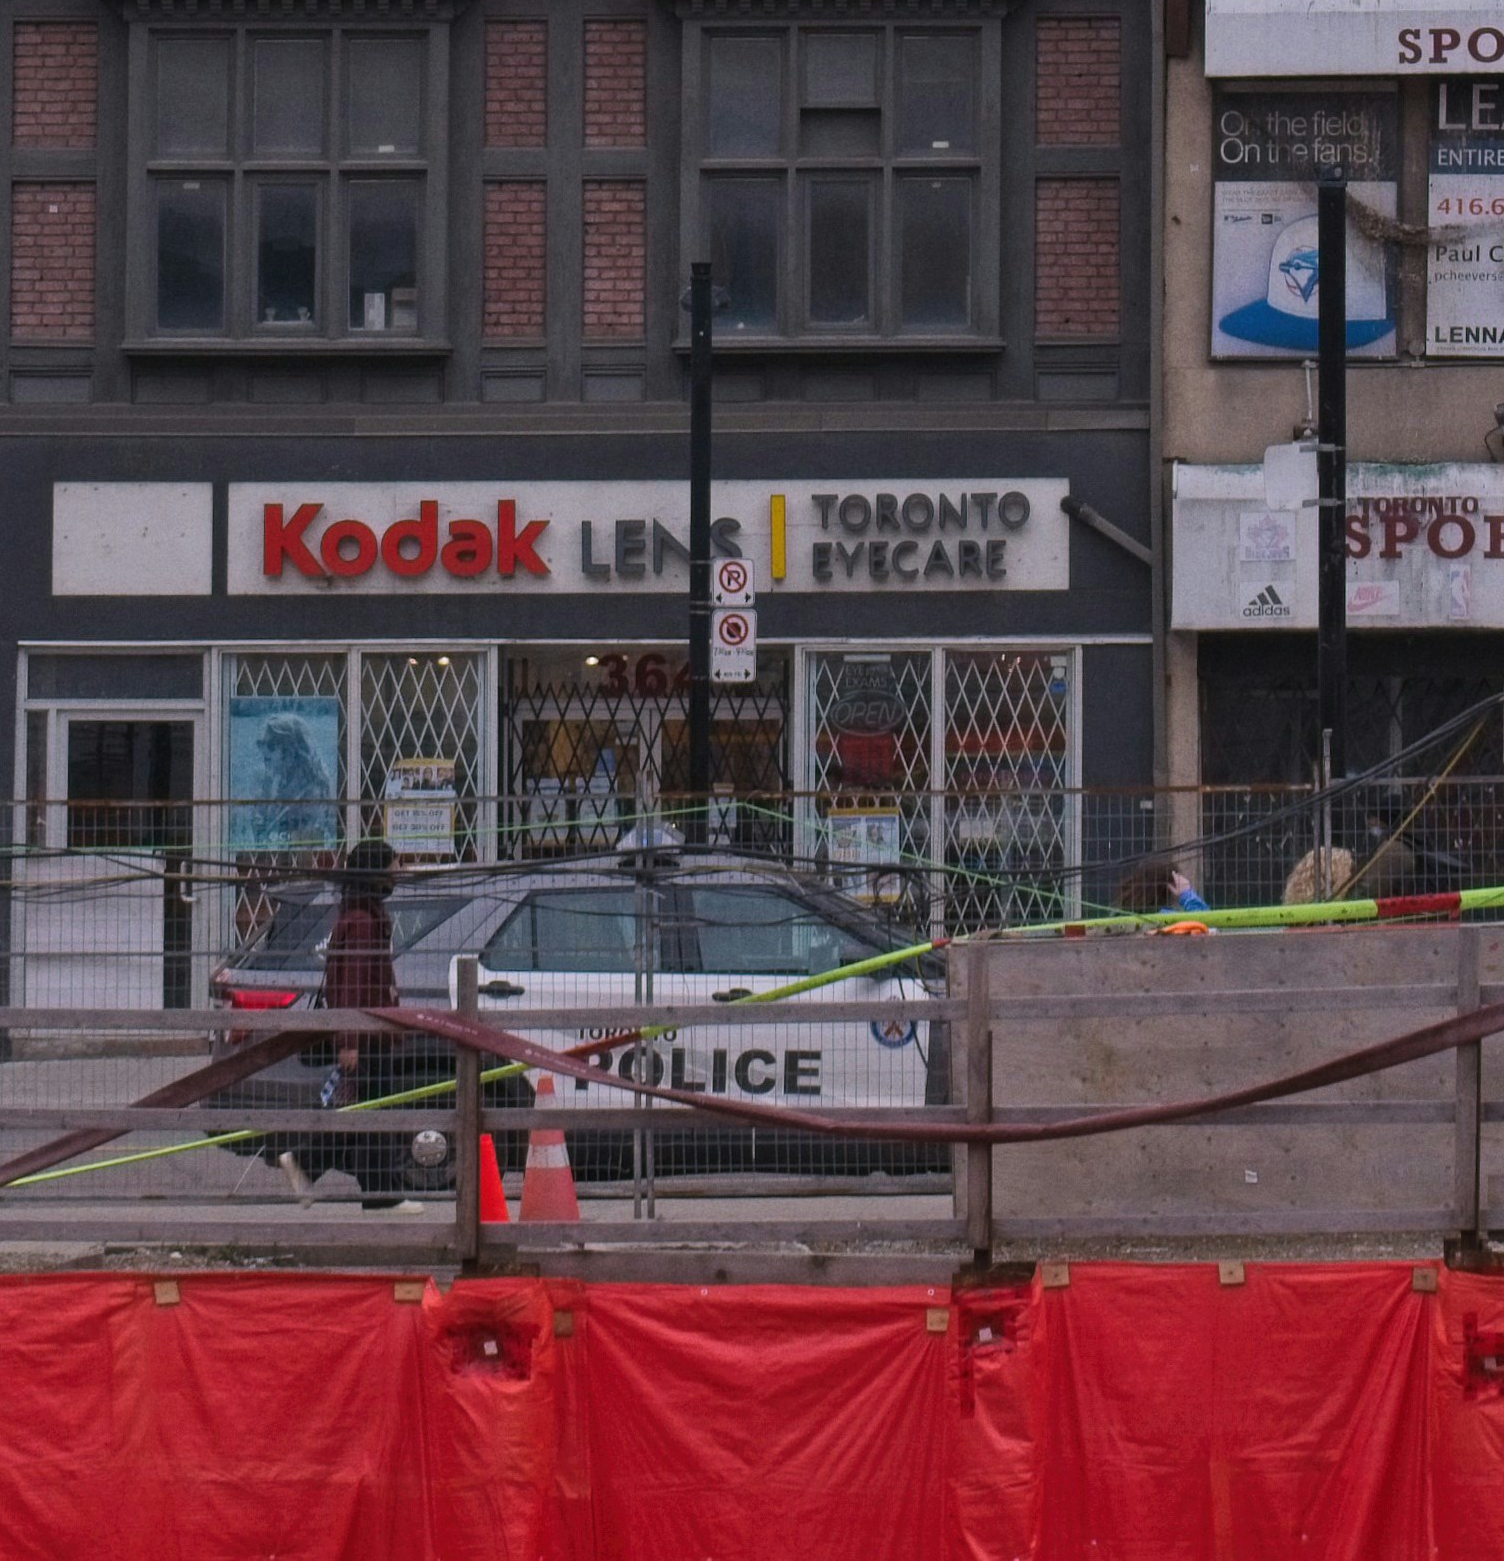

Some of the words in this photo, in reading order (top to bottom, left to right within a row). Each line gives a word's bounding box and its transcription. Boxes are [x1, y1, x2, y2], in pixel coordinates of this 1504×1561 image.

[1266, 110, 1308, 137] the
[1220, 137, 1261, 164] On
[1312, 137, 1374, 164] fans.
[1435, 245, 1481, 263] Paul
[811, 491, 1032, 532] TORONTO
[1361, 496, 1479, 515] TORONTO
[262, 499, 551, 578] Kodak
[580, 517, 744, 577] LENS
[811, 539, 1009, 581] EYECARE
[1242, 603, 1291, 618] adidas
[844, 664, 864, 676] EYE
[845, 677, 888, 689] EXAMS
[835, 701, 898, 725] OPEN
[575, 1047, 822, 1096] POLICE
